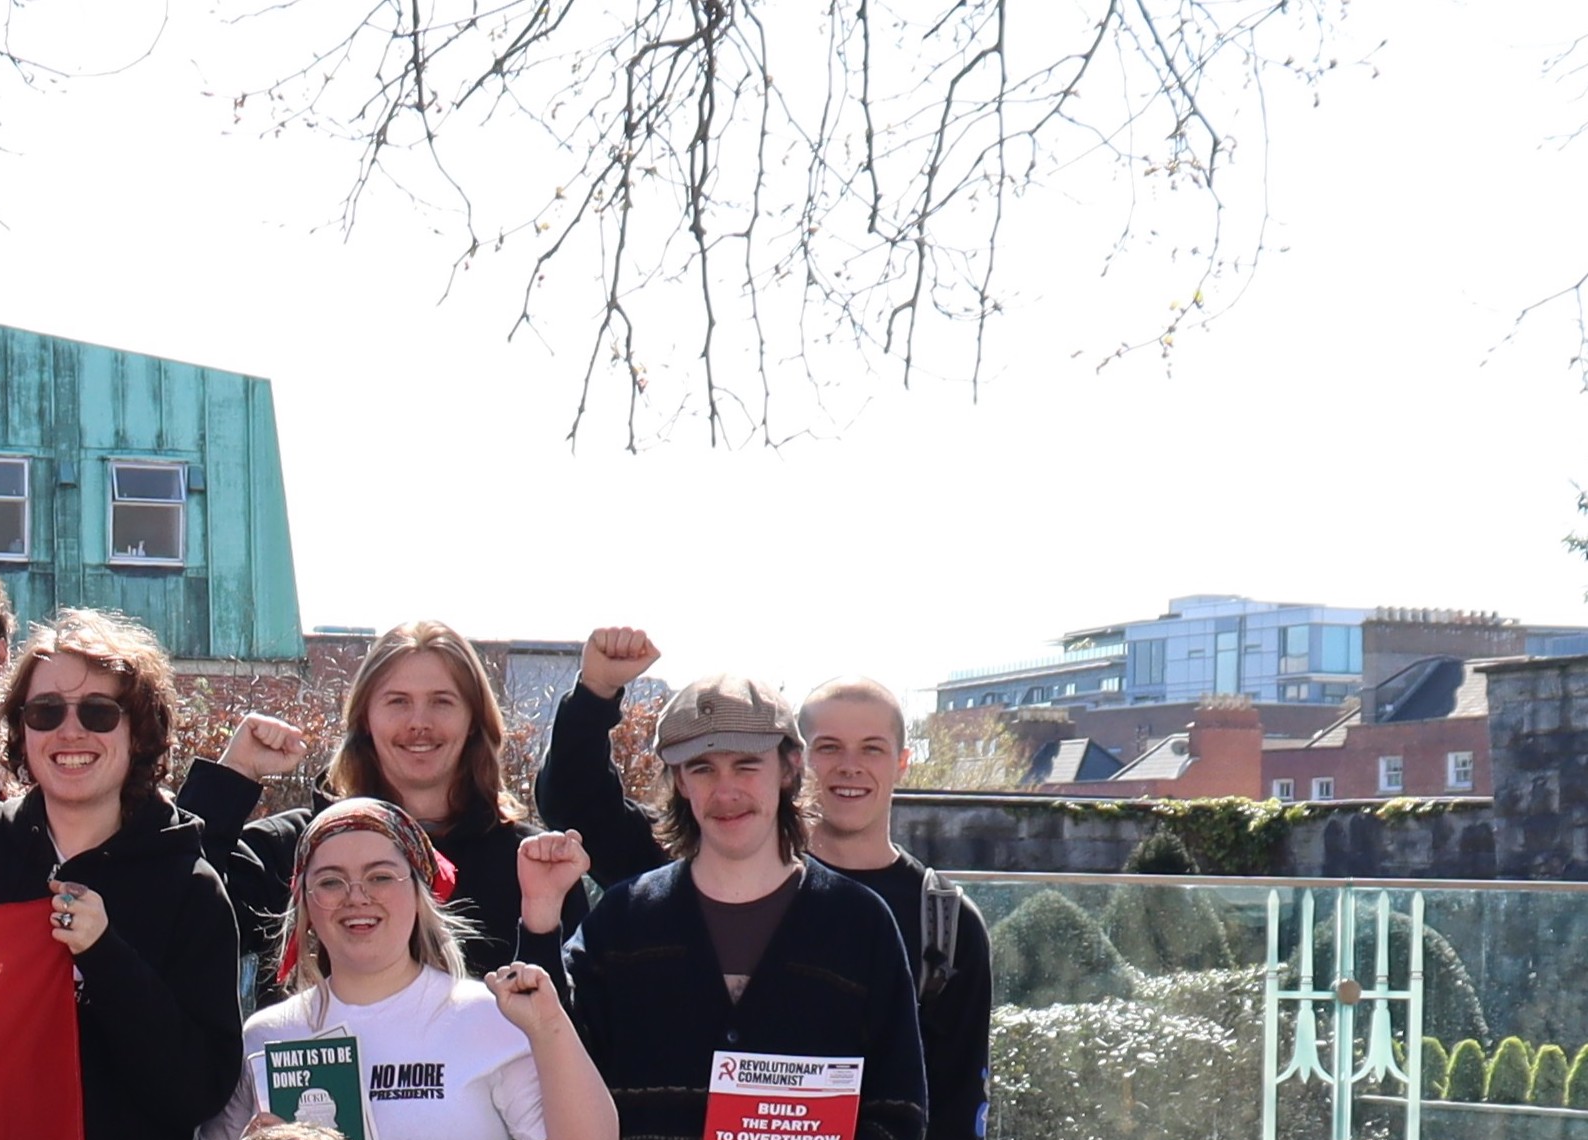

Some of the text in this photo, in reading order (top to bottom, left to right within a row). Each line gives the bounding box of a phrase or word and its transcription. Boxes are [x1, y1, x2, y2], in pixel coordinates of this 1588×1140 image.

[270, 1046, 353, 1068] WHAT IS TO BE
[739, 1059, 824, 1075] REVOLUTIONARY
[273, 1070, 311, 1089] DONE?
[370, 1063, 445, 1089] NO MORE
[738, 1072, 804, 1086] COMMUNIST
[369, 1088, 445, 1101] PRESIDENTS
[758, 1103, 808, 1117] BUILD
[742, 1118, 821, 1131] THE PARTY
[716, 1131, 733, 1140] TO
